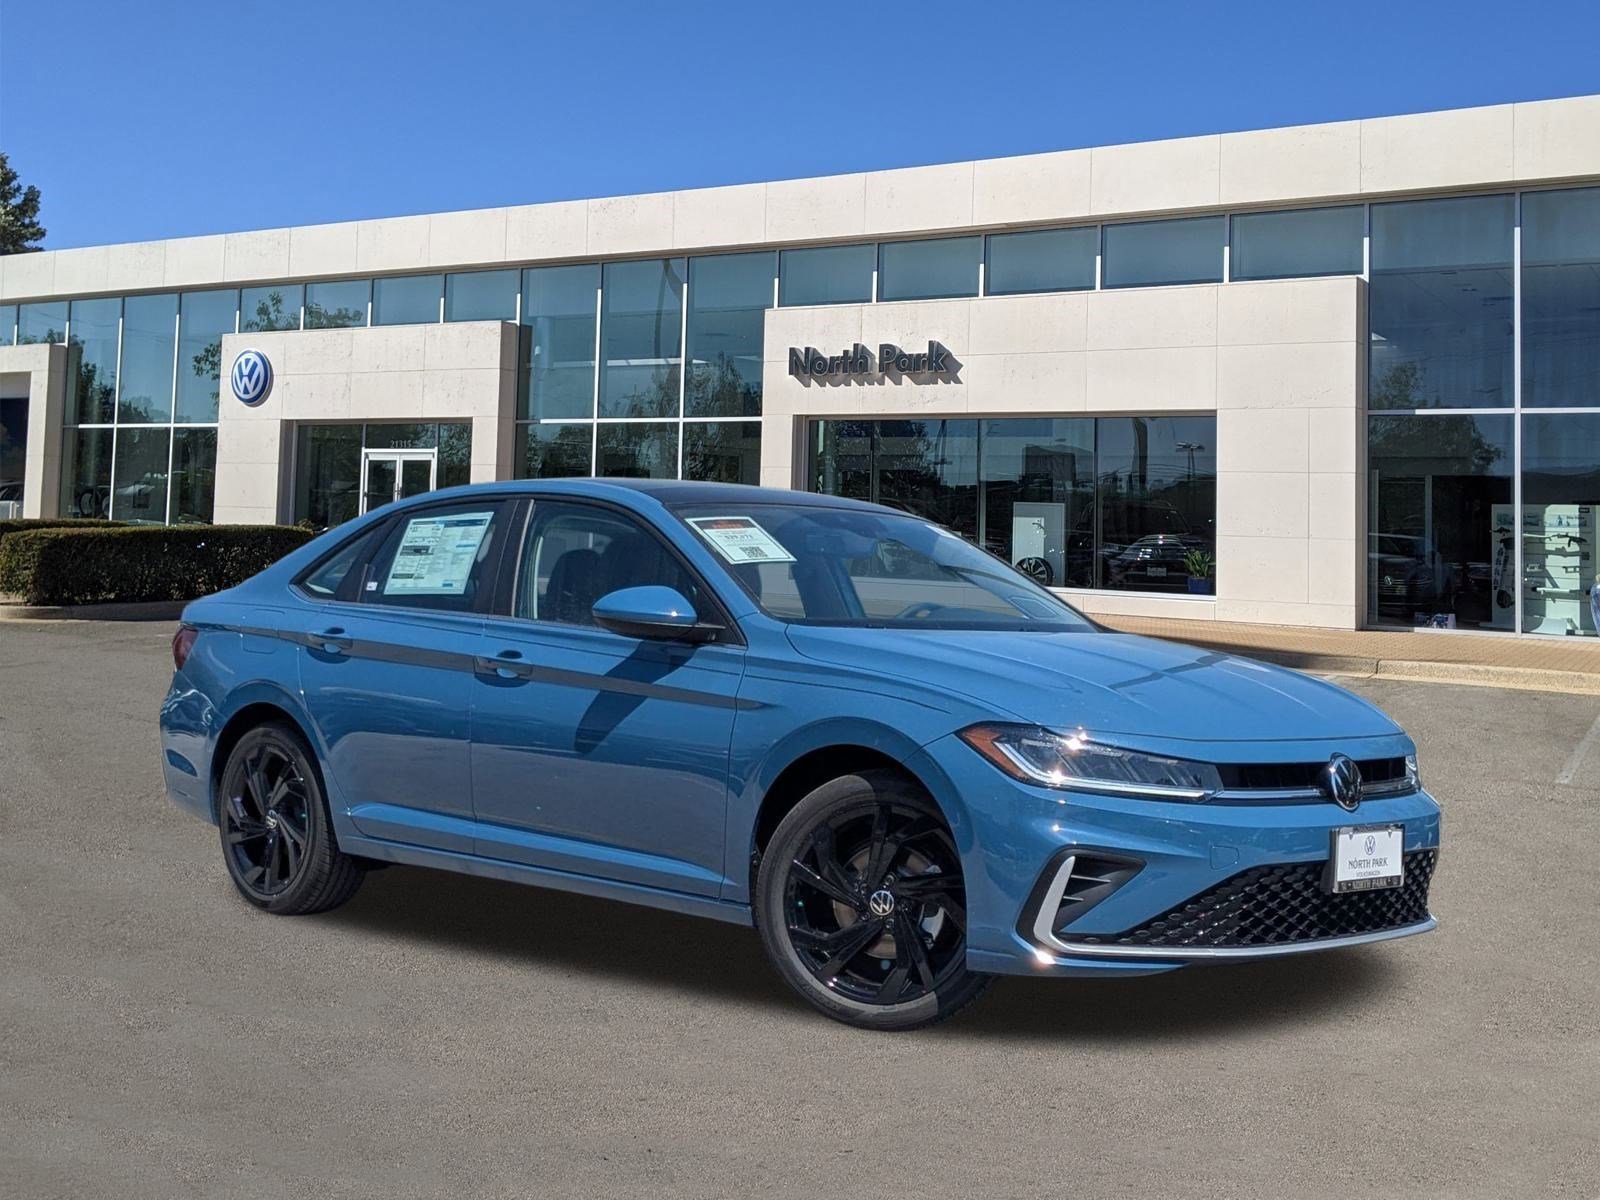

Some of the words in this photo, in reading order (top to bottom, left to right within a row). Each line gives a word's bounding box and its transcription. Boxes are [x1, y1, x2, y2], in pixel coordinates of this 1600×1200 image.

[788, 343, 873, 376] North
[878, 340, 949, 373] Park
[390, 439, 412, 448] 21315
[1348, 859, 1371, 870] NORTH
[1372, 857, 1388, 868] PARK
